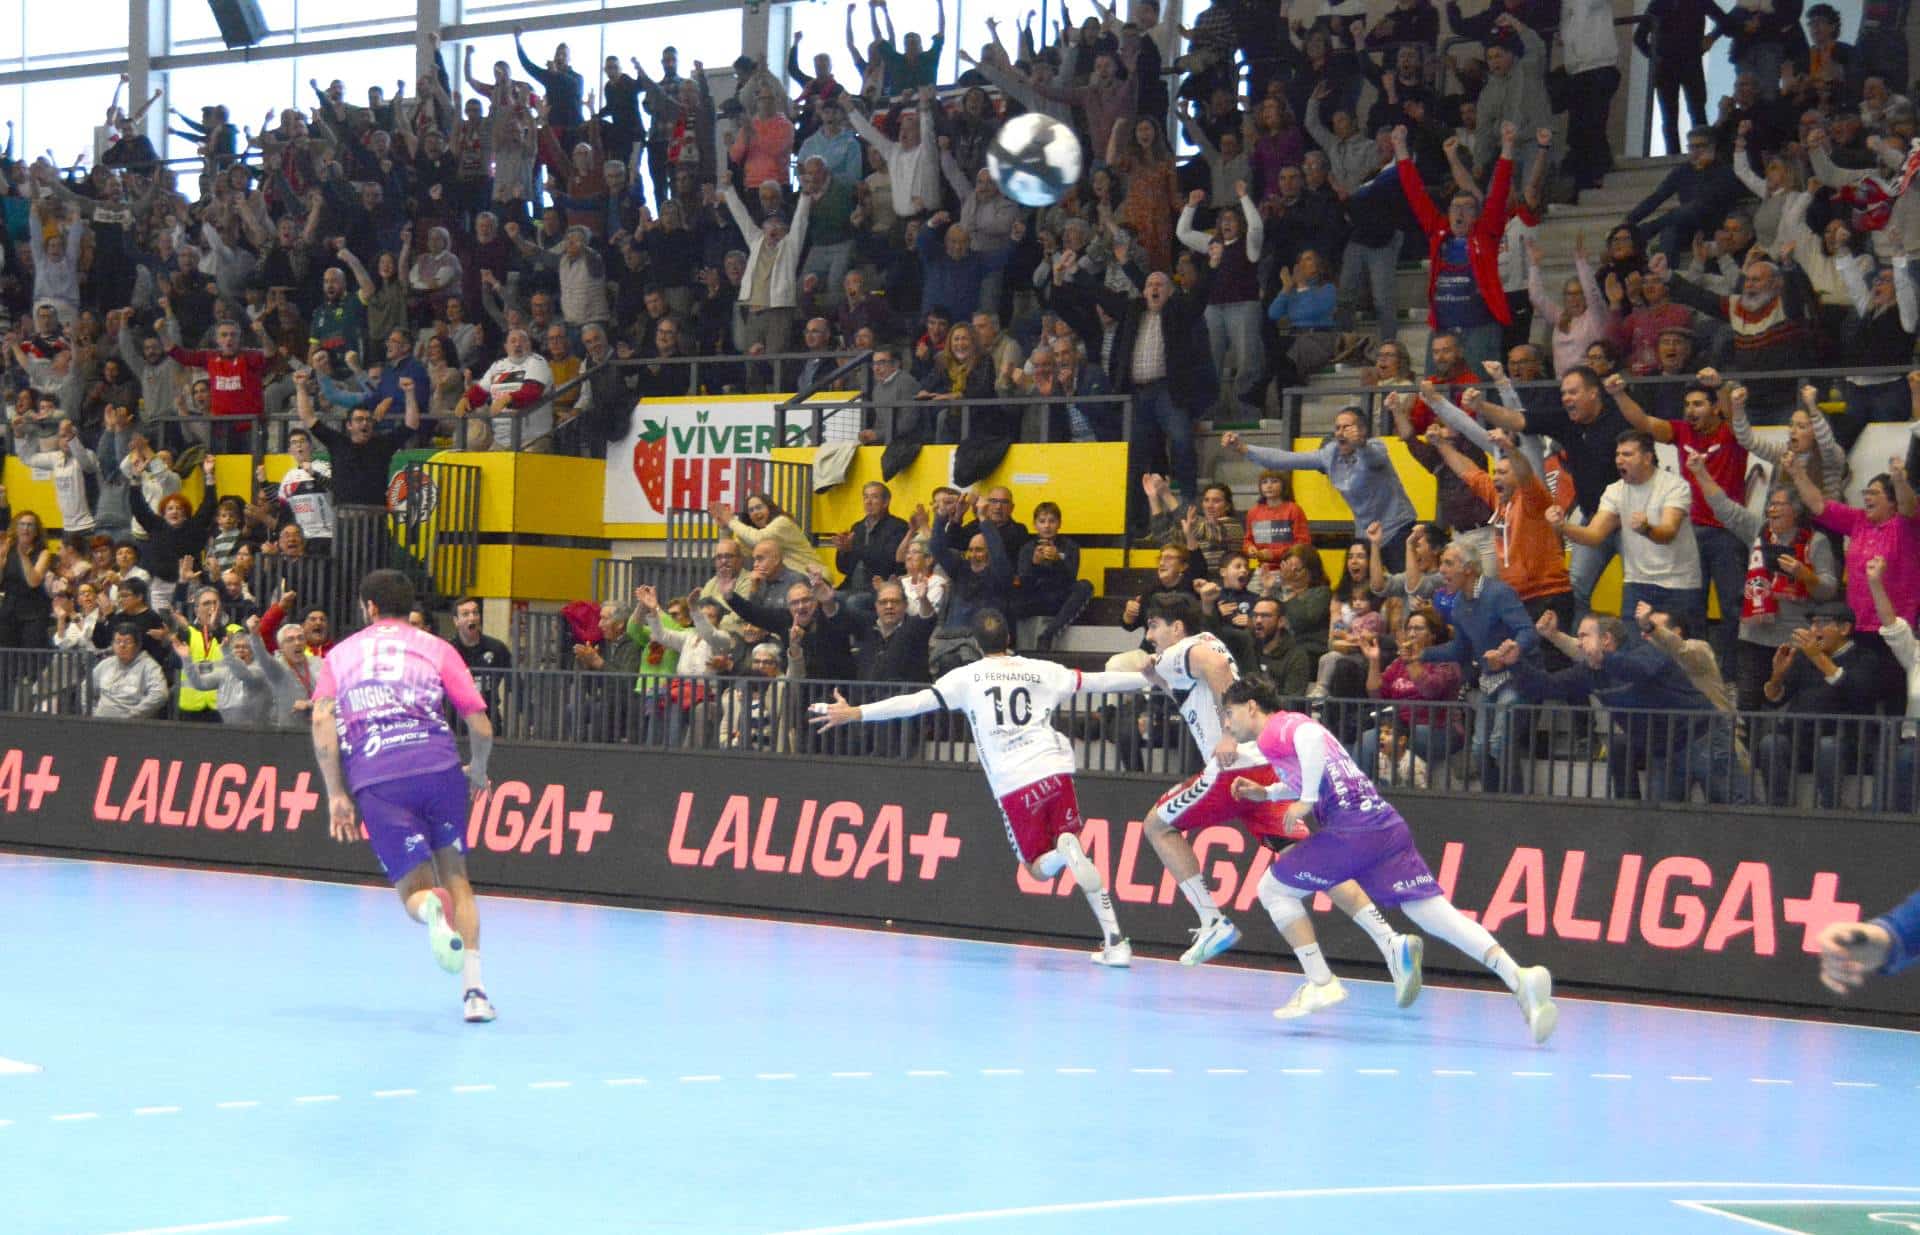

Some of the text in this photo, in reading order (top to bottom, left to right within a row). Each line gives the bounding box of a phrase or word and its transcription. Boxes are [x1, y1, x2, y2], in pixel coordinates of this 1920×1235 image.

[359, 638, 407, 681] 19
[984, 686, 1033, 726] 10
[93, 756, 319, 831] LALIGA+
[668, 792, 961, 881] LALIGA+
[1437, 842, 1861, 955] LALIGA+
